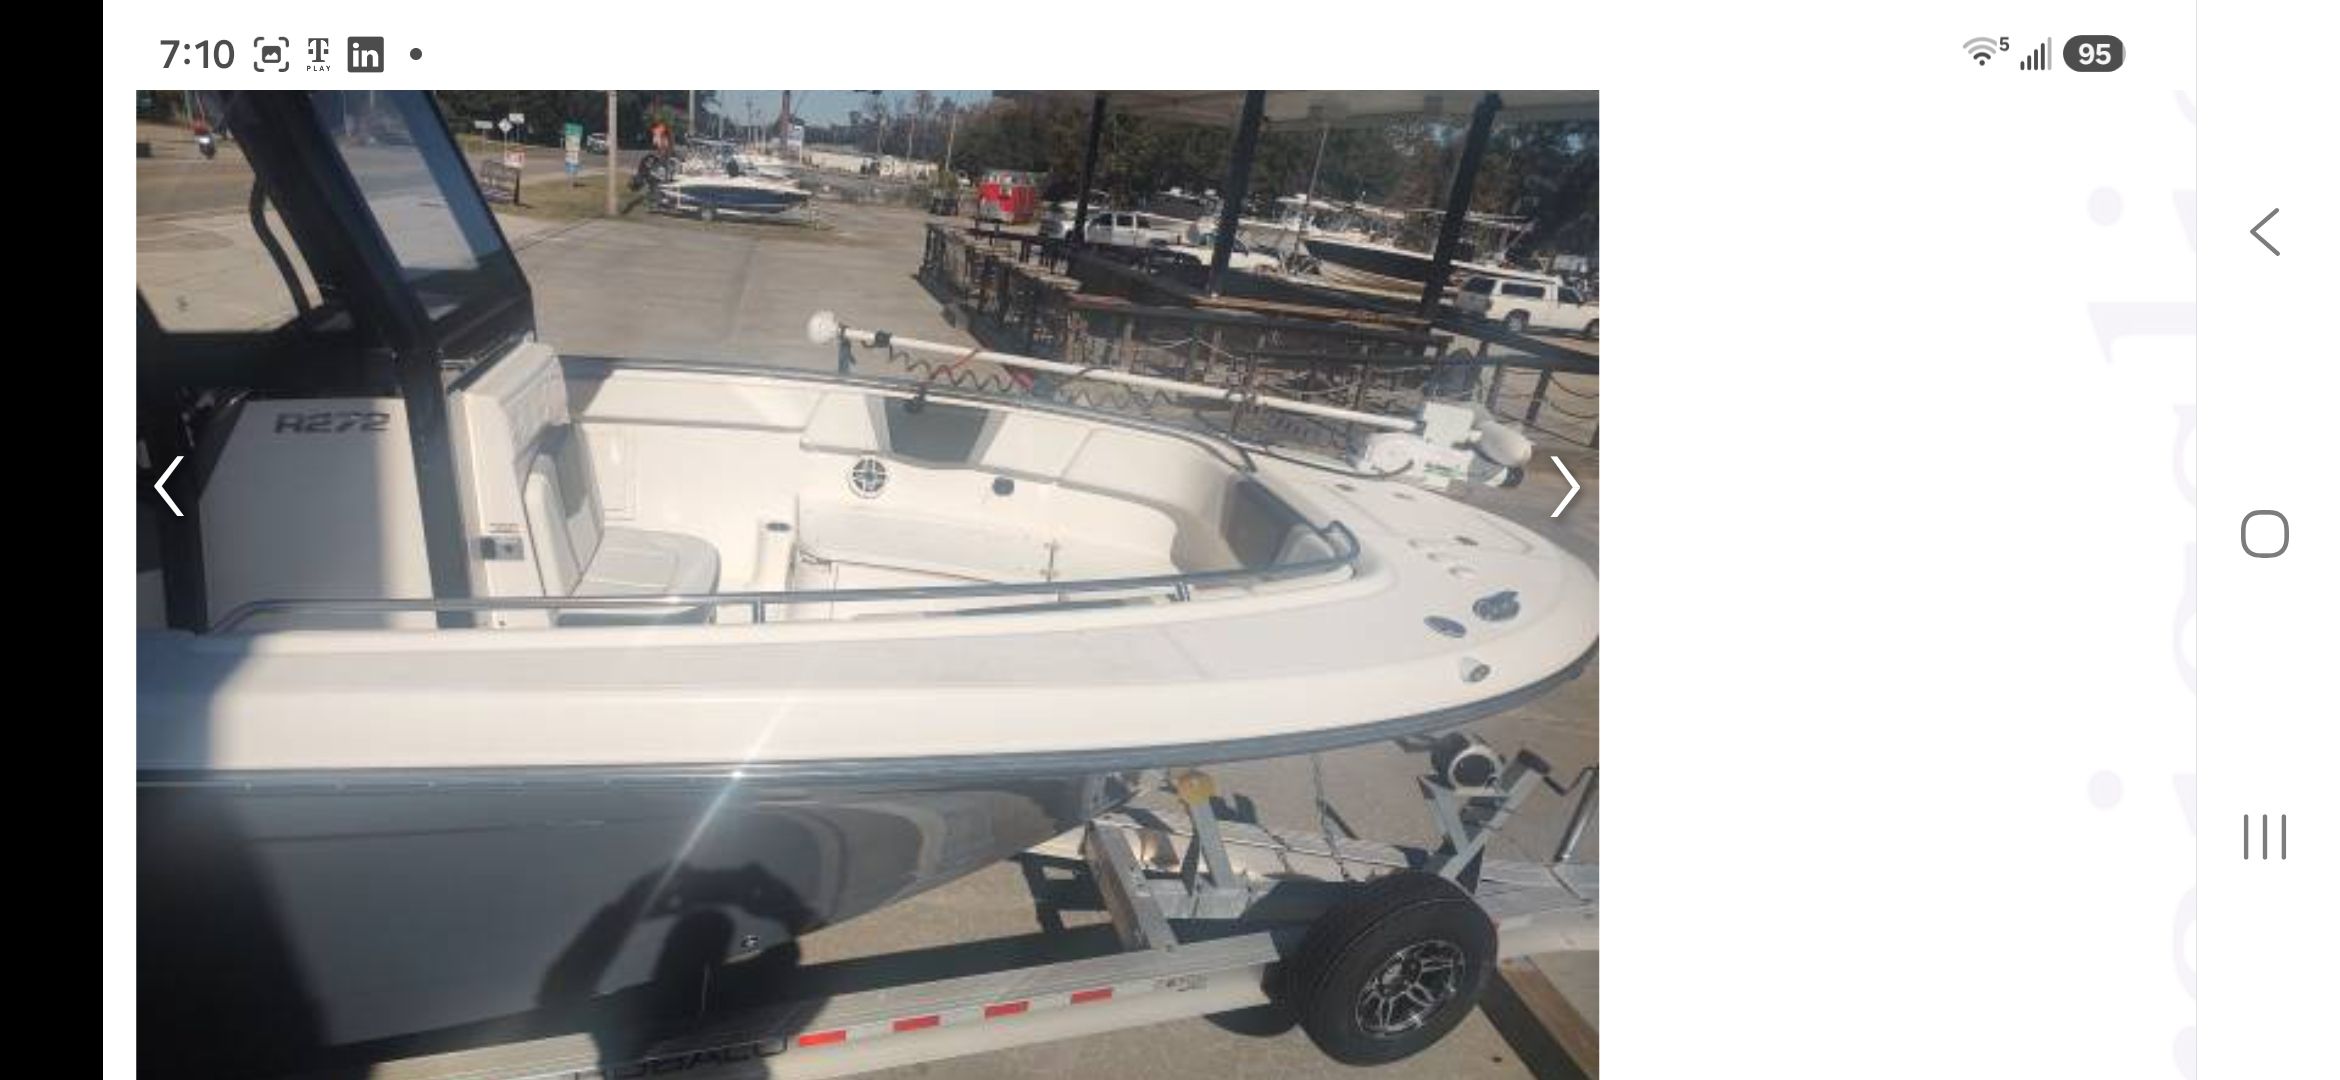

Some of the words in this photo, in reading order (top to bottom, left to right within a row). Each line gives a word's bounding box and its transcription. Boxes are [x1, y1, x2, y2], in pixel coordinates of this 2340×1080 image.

[160, 39, 235, 69] 7:10
[352, 42, 379, 68] in
[1999, 36, 2010, 52] 5
[2078, 43, 2112, 65] 95
[274, 411, 391, 434] R272
